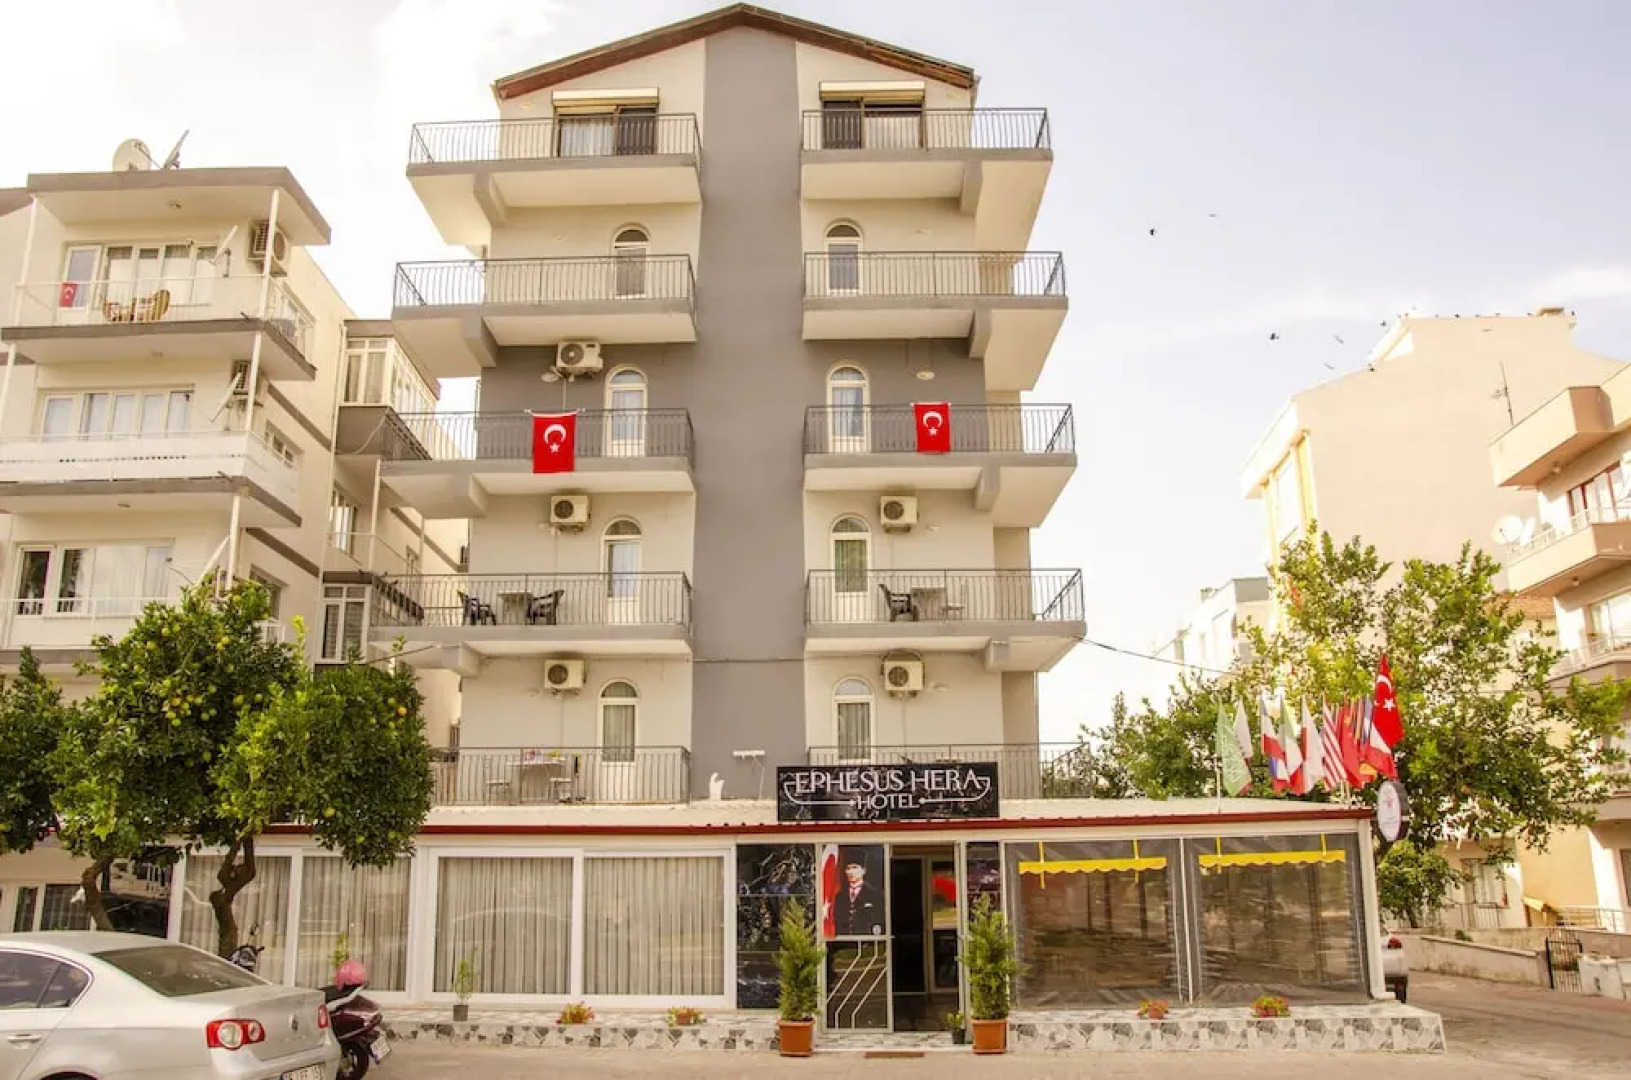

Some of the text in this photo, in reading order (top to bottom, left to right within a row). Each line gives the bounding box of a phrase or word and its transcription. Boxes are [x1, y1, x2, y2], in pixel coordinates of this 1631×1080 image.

[795, 769, 982, 794] EPHESUS HERA
[857, 793, 919, 810] HOTEL
